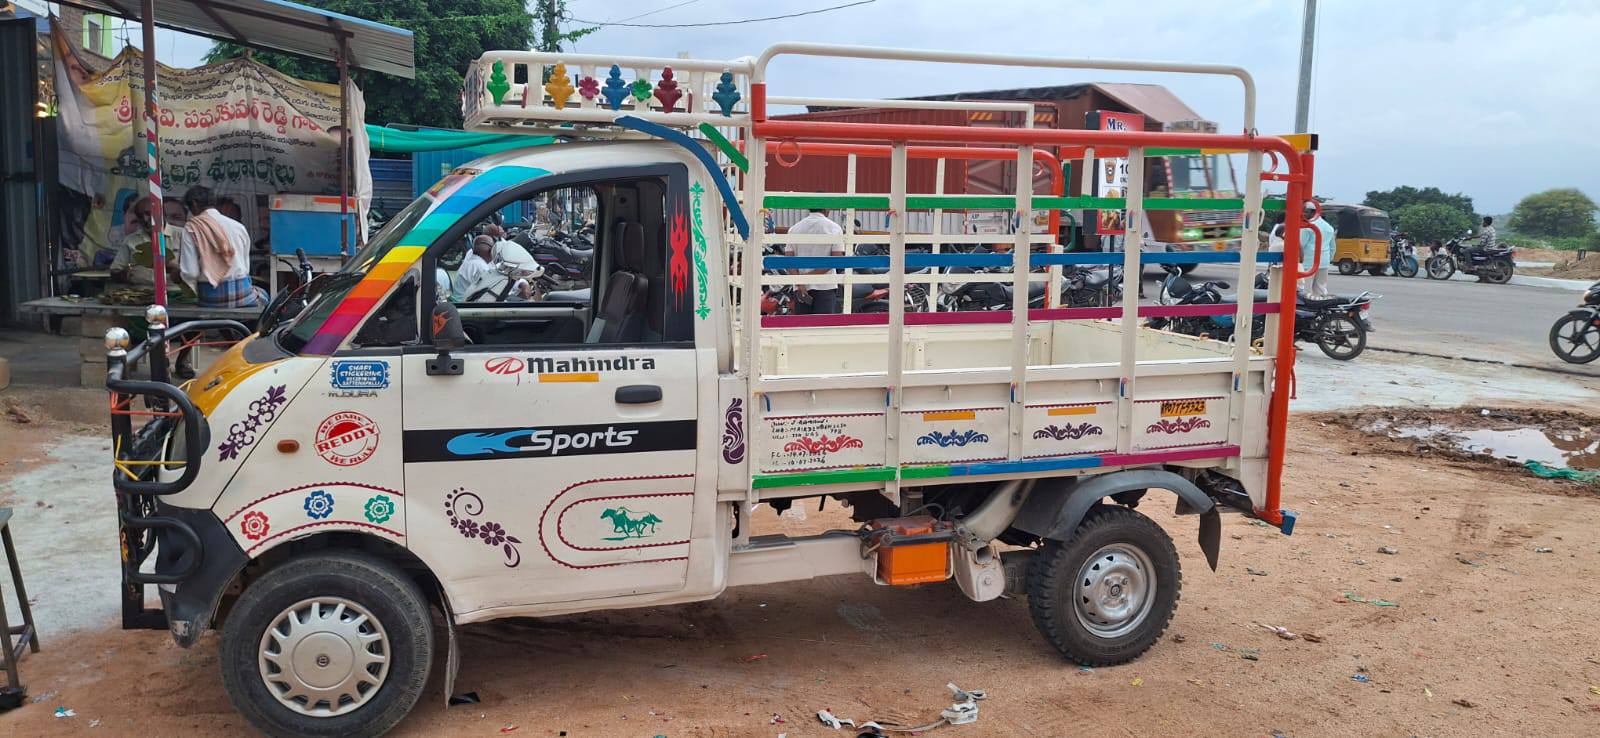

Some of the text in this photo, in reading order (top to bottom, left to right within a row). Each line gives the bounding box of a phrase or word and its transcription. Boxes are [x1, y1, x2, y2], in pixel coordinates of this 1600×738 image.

[527, 356, 656, 374] Mahindra
[317, 425, 375, 452] REDDY
[520, 426, 639, 455] Sports
